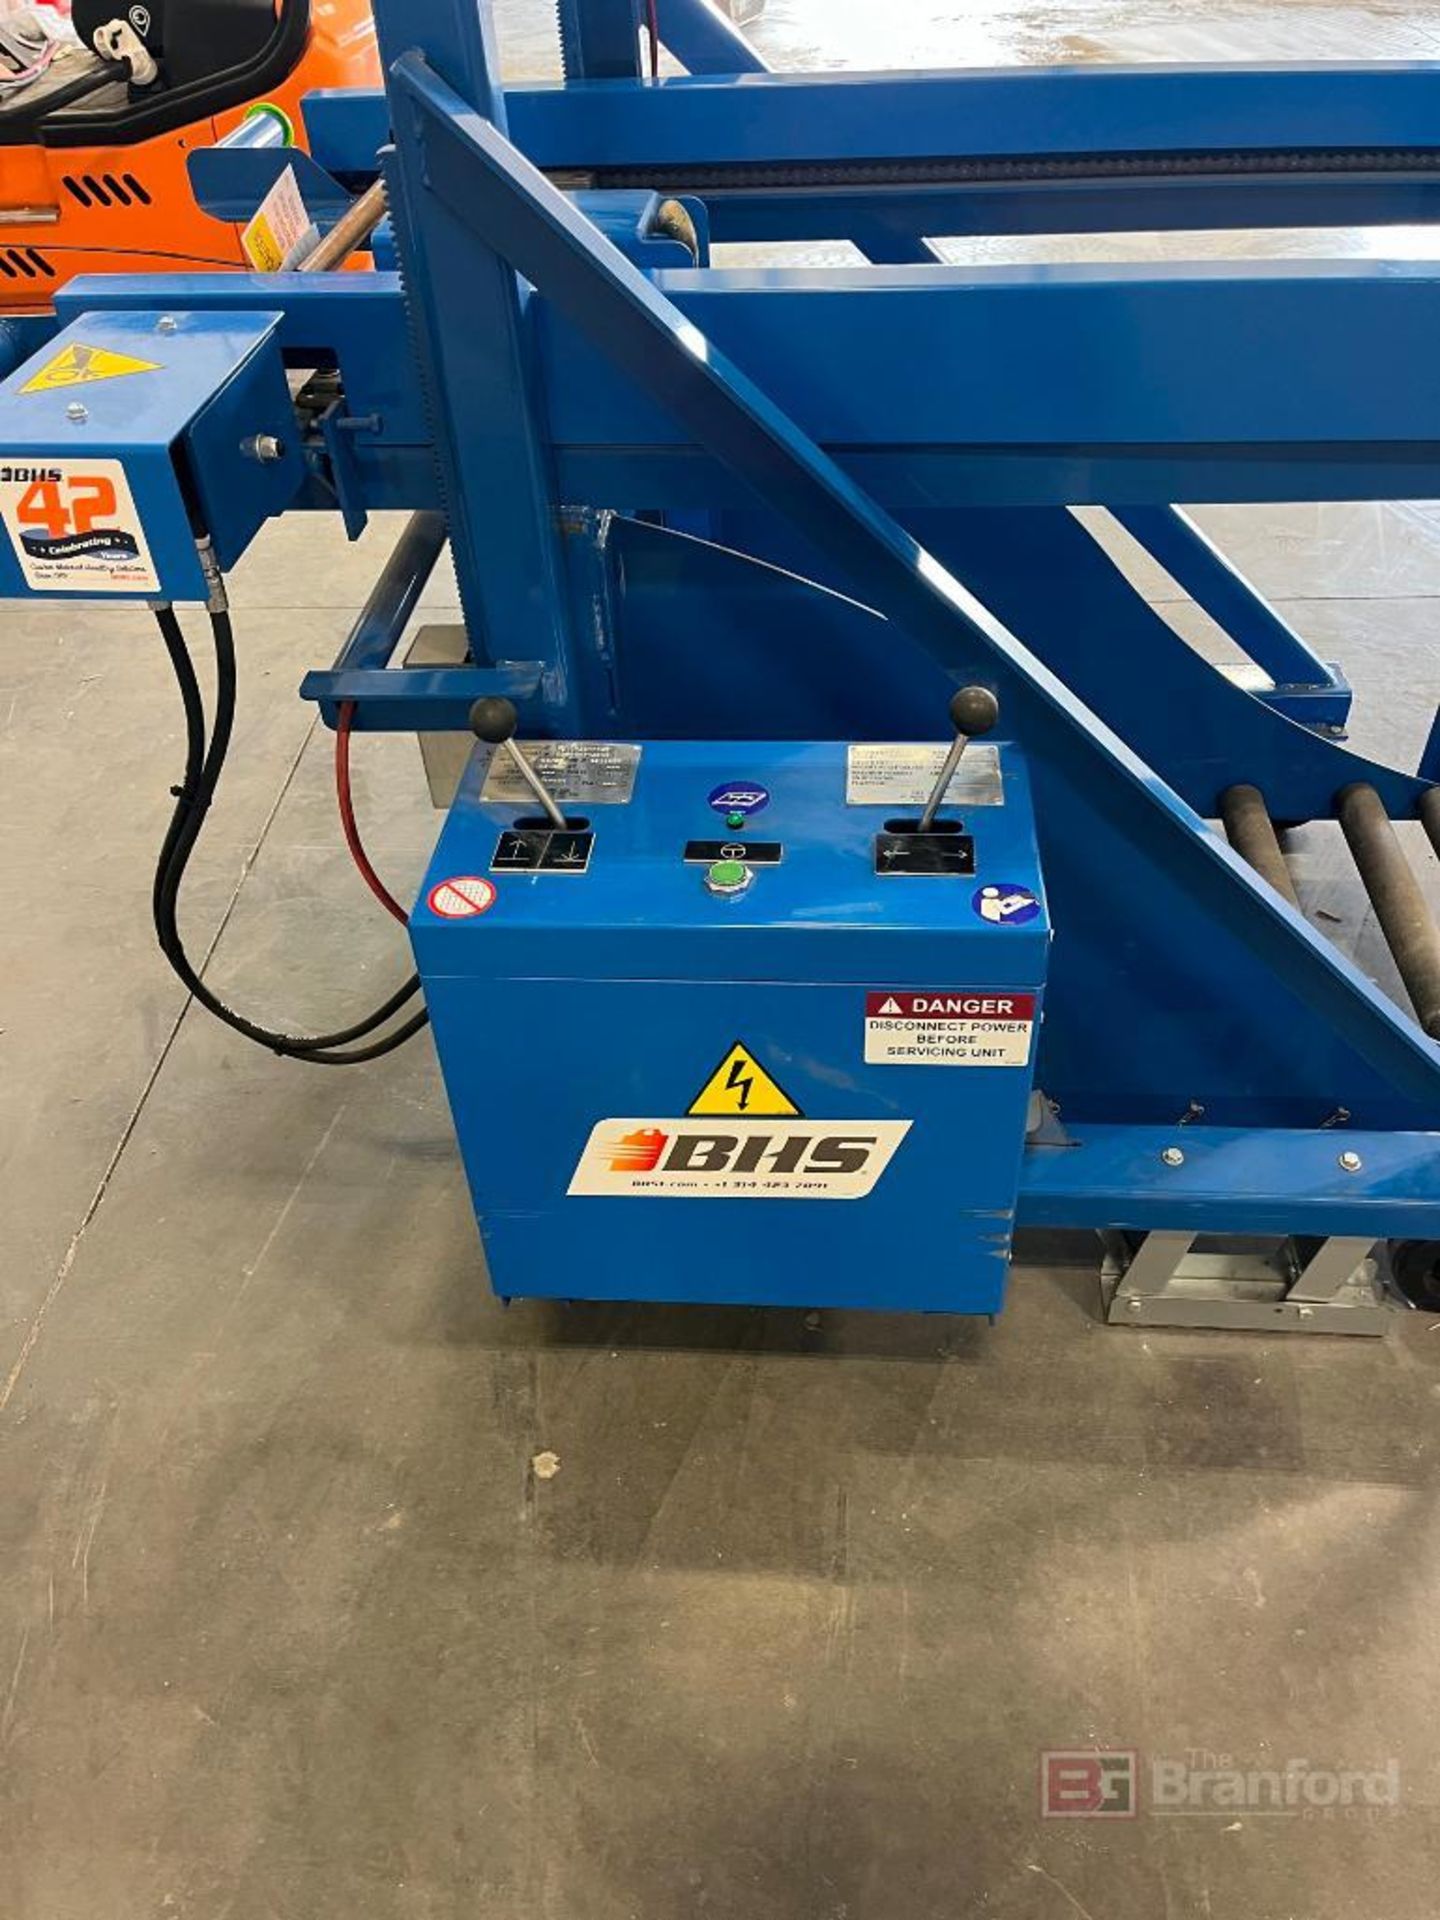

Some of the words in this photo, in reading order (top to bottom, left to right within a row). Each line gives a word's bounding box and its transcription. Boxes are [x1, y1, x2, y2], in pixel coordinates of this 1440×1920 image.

[14, 468, 62, 483] BHS
[17, 476, 117, 539] 42
[49, 536, 111, 555] Celebrating
[100, 551, 128, 560] Years
[912, 998, 1014, 1015] DANGER
[870, 1020, 965, 1032] DISCONNECT
[971, 1022, 1028, 1033] POWER
[917, 1035, 978, 1044] BEFORE
[887, 1046, 967, 1058] SERVICING
[971, 1048, 1007, 1058] UNIT
[661, 1134, 878, 1173] BHS
